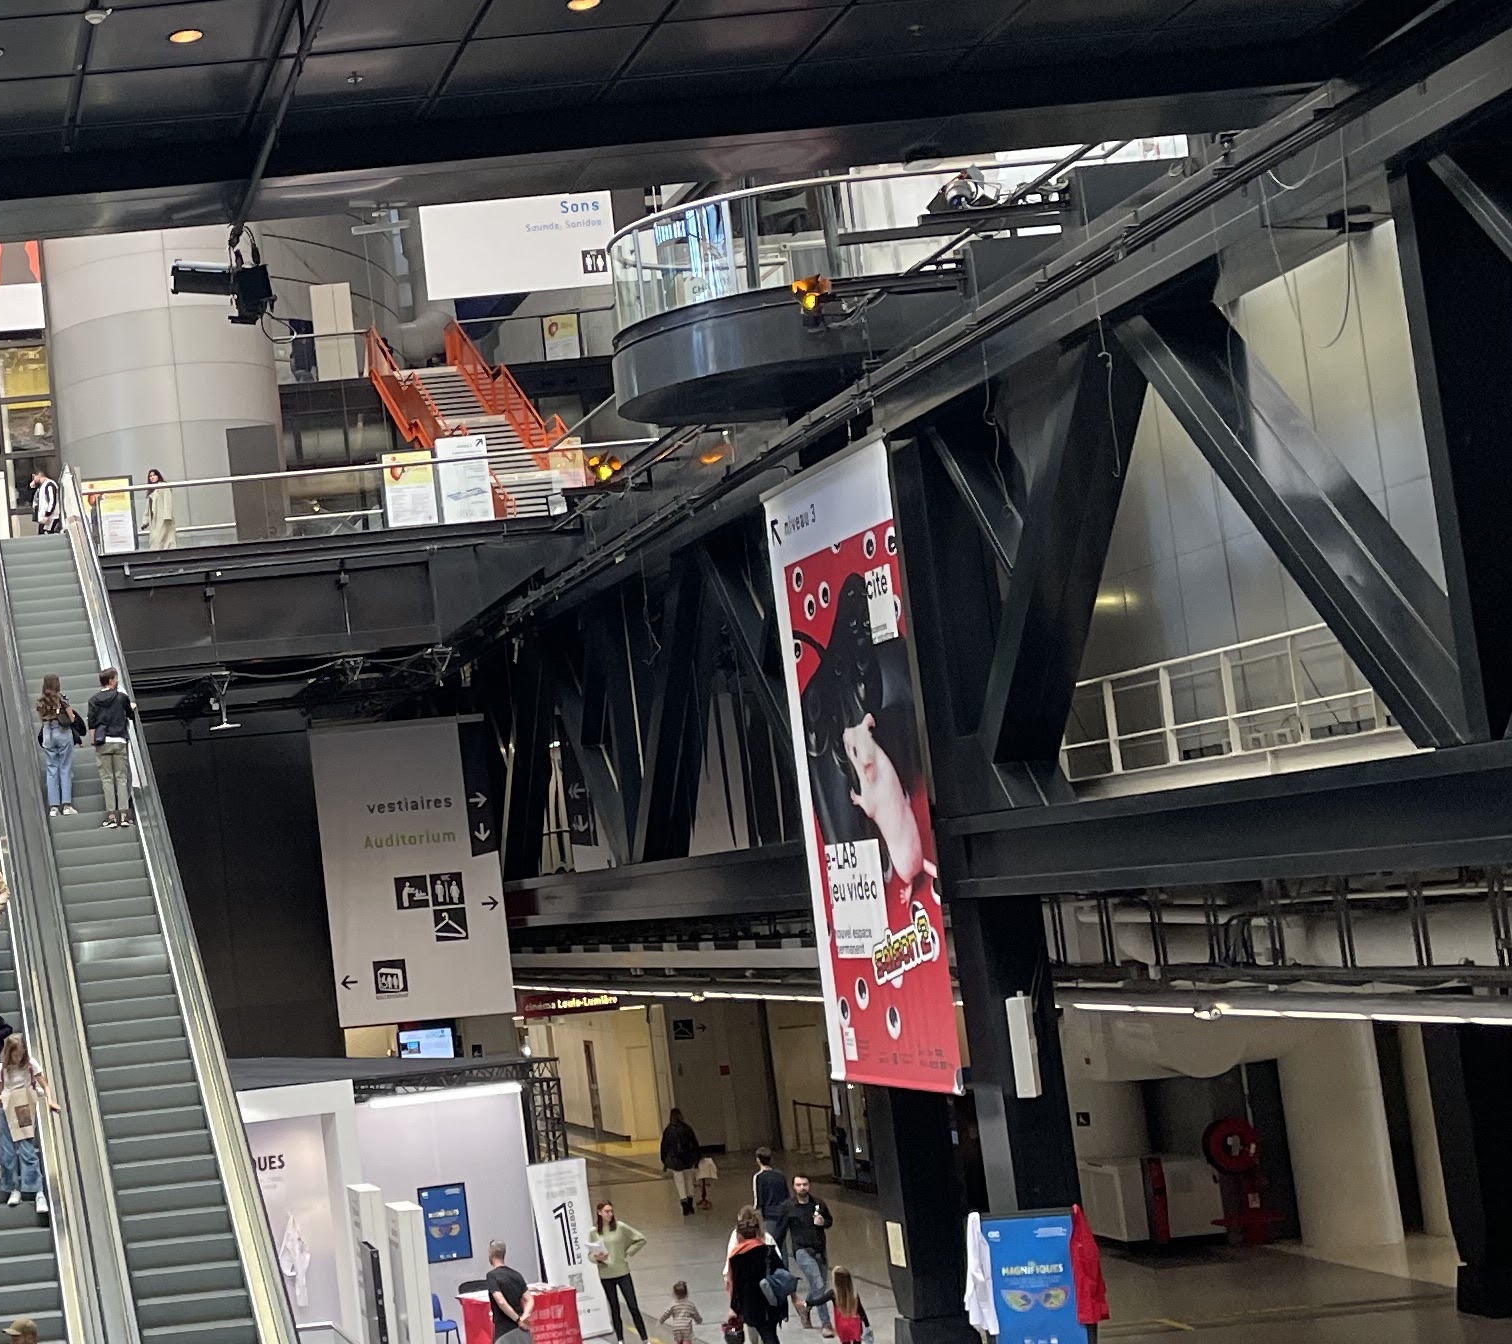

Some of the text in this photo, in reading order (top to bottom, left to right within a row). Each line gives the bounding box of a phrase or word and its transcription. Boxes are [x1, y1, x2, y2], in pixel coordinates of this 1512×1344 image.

[560, 199, 600, 214] Sons
[784, 503, 817, 535] niveau 3
[865, 565, 889, 600] cité
[366, 796, 453, 814] vestiaires
[364, 829, 457, 849] Auditorium
[848, 874, 878, 903] vidéo
[567, 1200, 578, 1234] HEBDO
